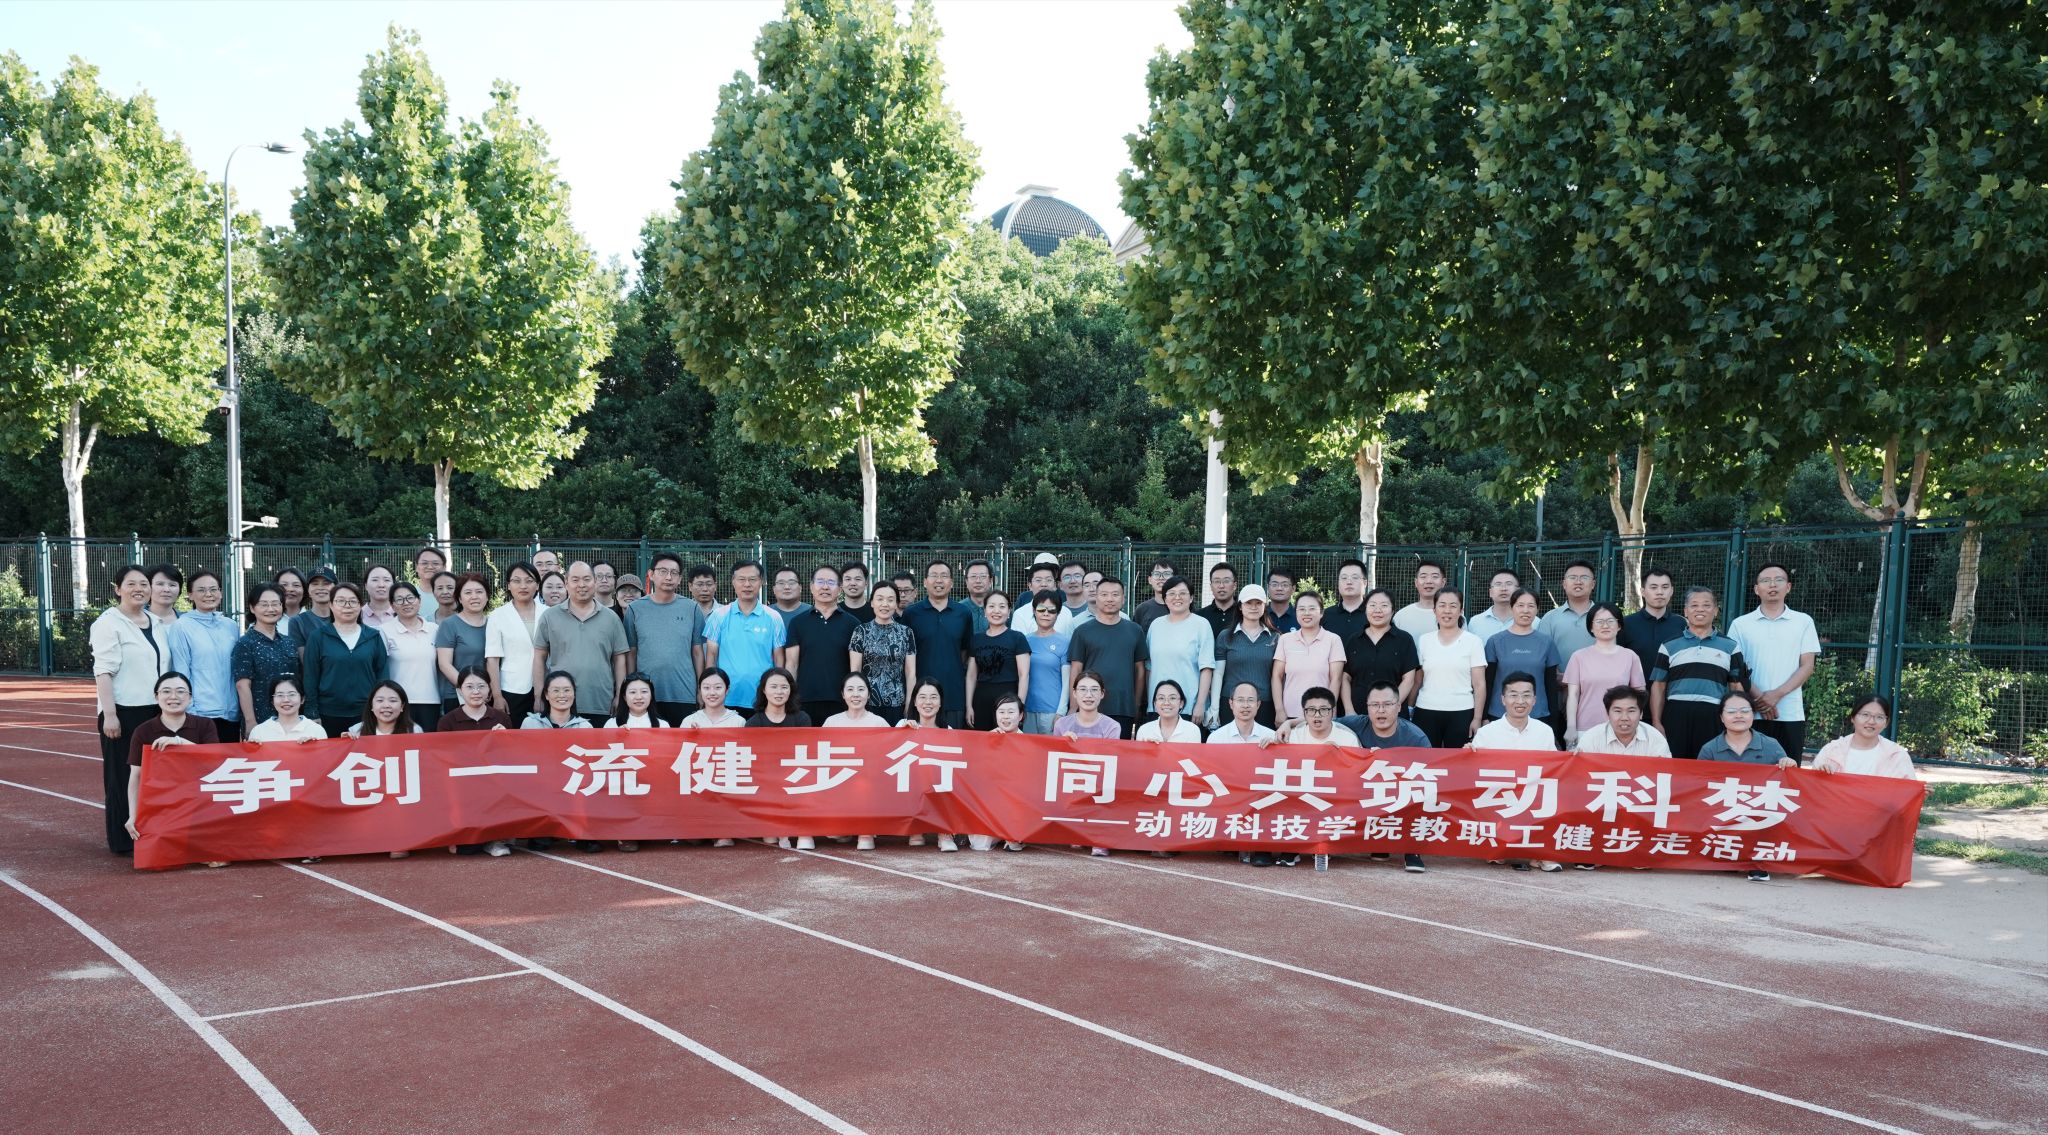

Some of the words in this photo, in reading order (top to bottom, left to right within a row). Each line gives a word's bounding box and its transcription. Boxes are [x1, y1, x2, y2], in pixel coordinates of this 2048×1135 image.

[199, 740, 968, 815] 争创一流健步行
[1043, 750, 1802, 831] 同心共筑动科梦
